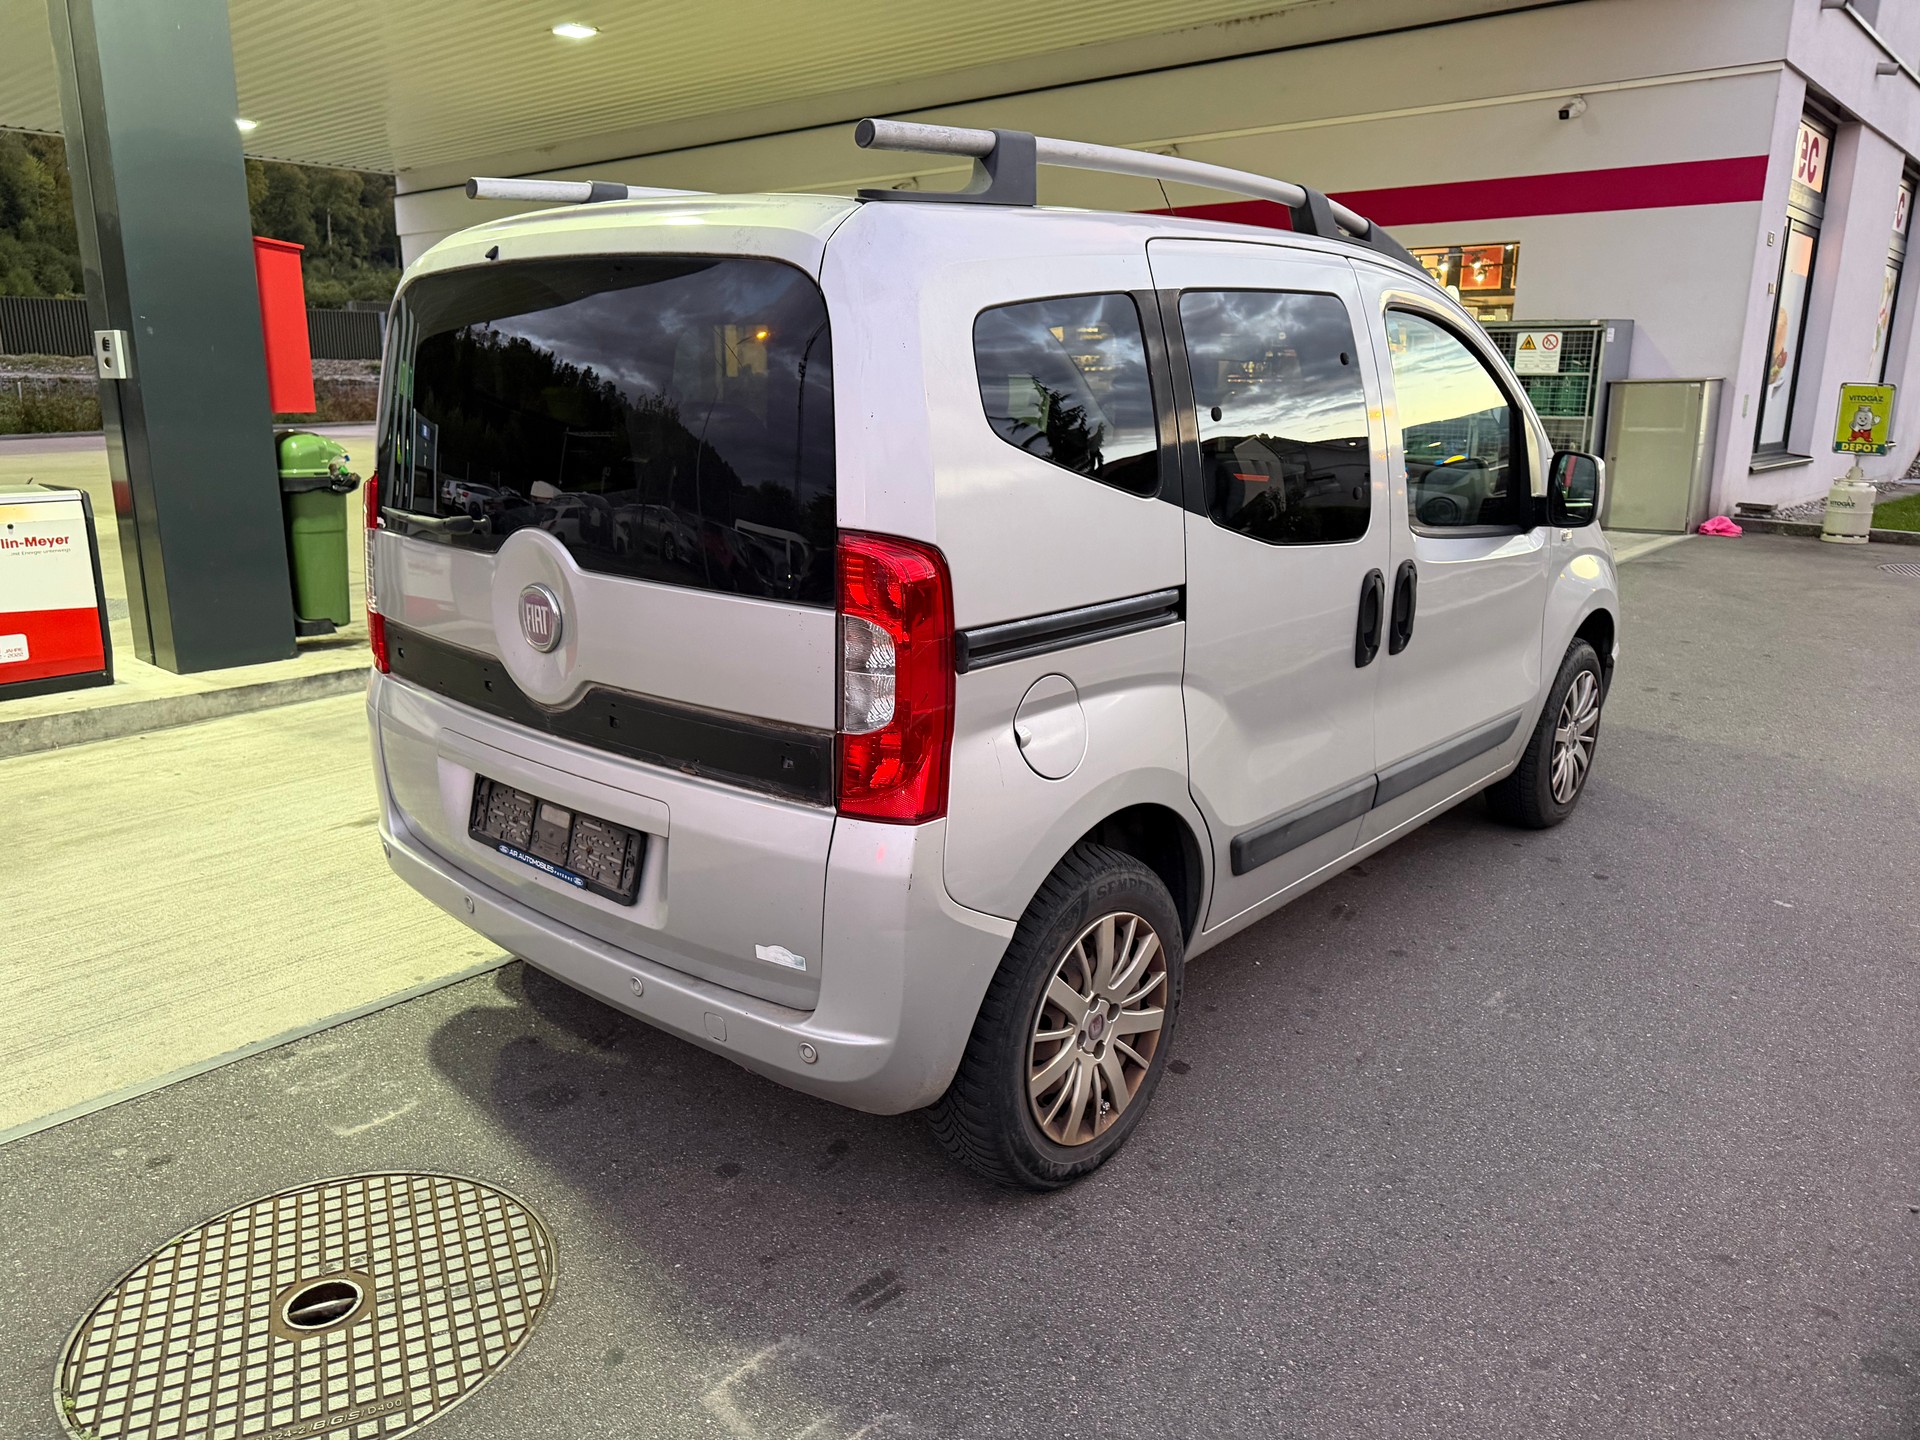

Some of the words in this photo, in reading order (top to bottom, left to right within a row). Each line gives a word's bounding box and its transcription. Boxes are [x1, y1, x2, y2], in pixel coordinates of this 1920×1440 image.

[1849, 394, 1884, 402] VITOGAZ
[1841, 442, 1879, 453] DEPOT
[0, 535, 70, 550] lin-Meyer
[525, 603, 549, 635] FIAT
